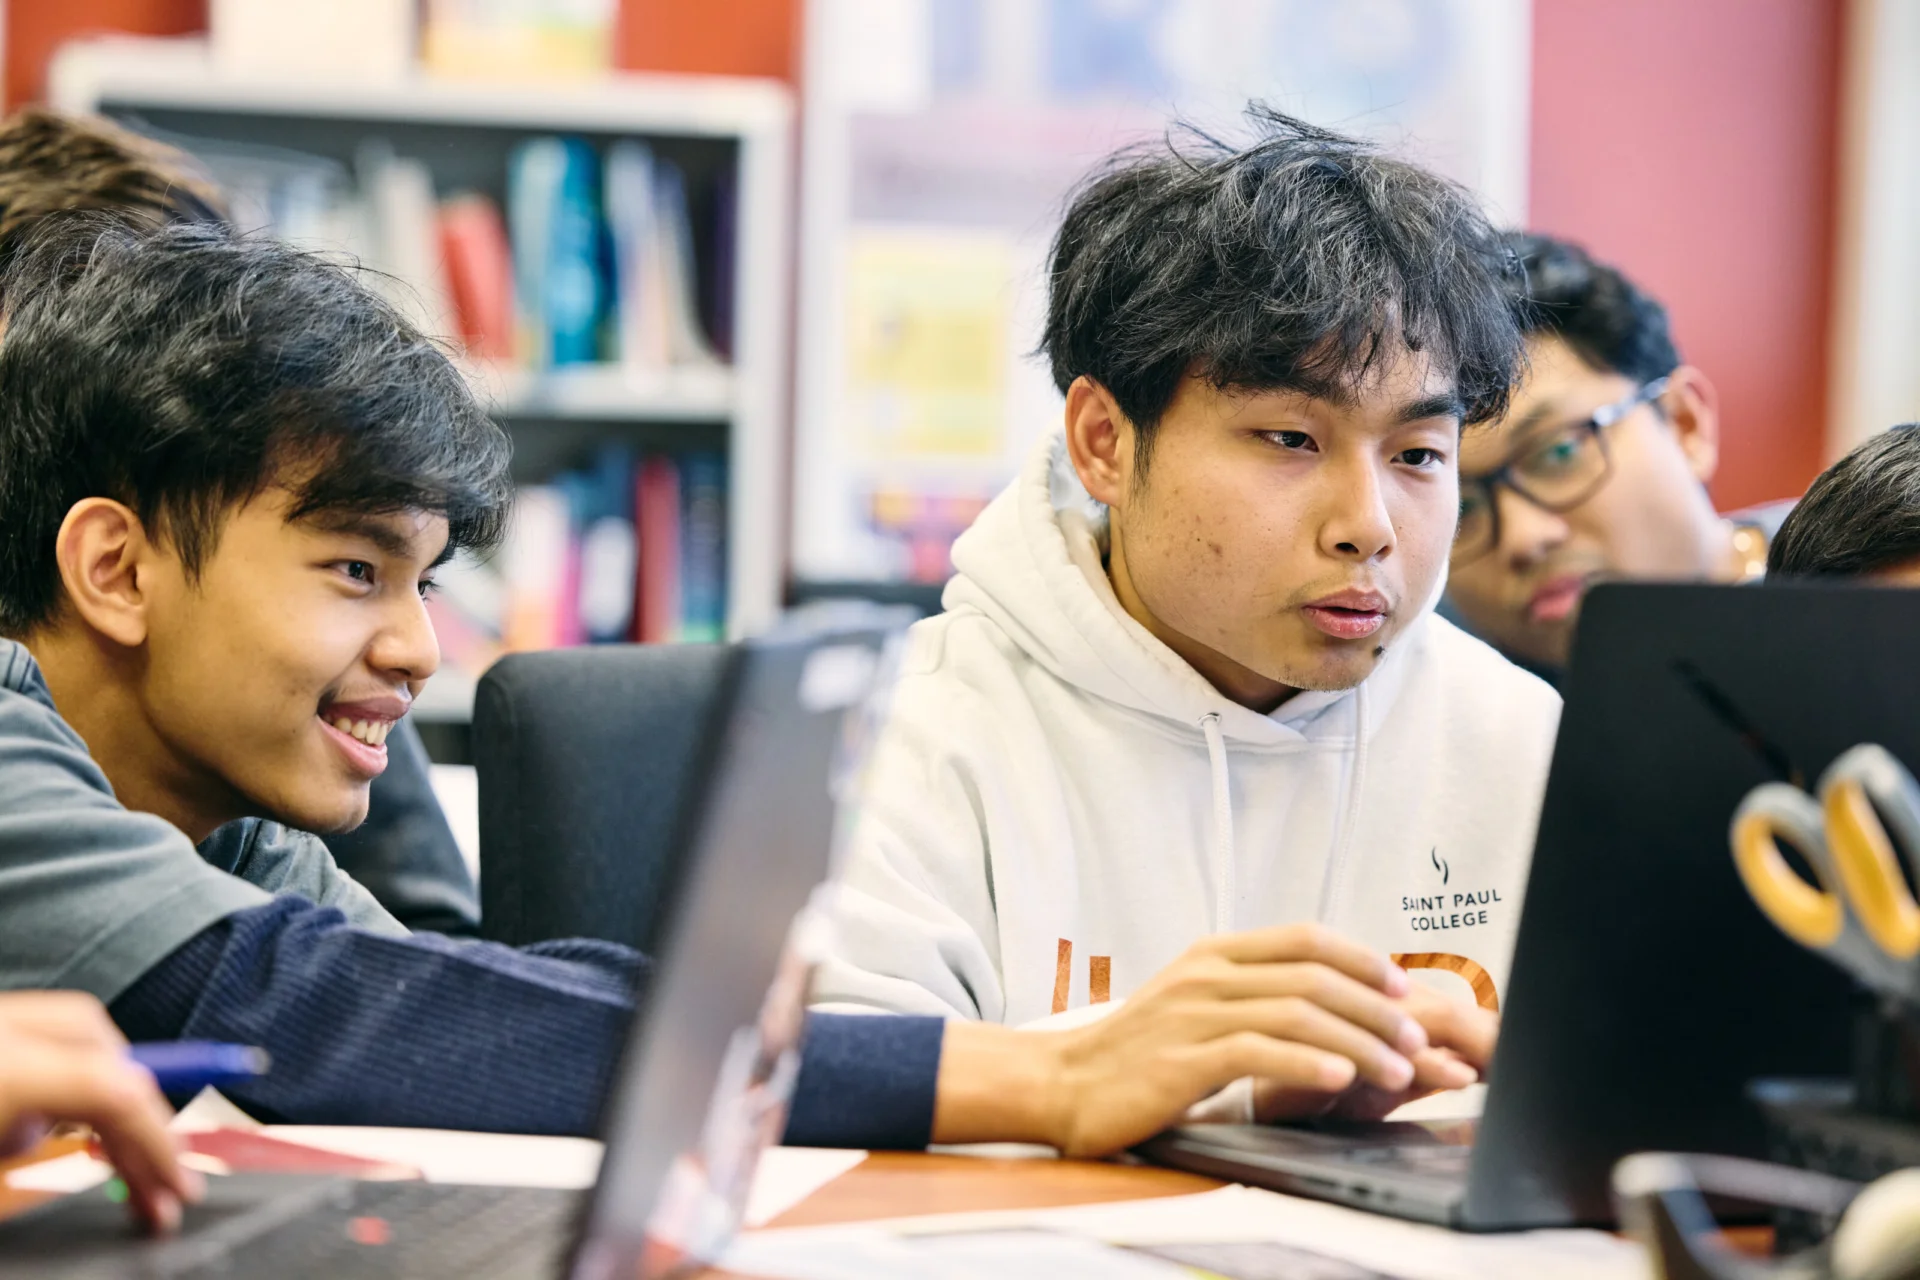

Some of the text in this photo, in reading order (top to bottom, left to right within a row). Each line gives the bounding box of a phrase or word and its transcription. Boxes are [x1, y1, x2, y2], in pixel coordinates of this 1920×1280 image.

[1402, 889, 1502, 911] SAINT PAUL
[1411, 911, 1488, 931] COLLEGE
